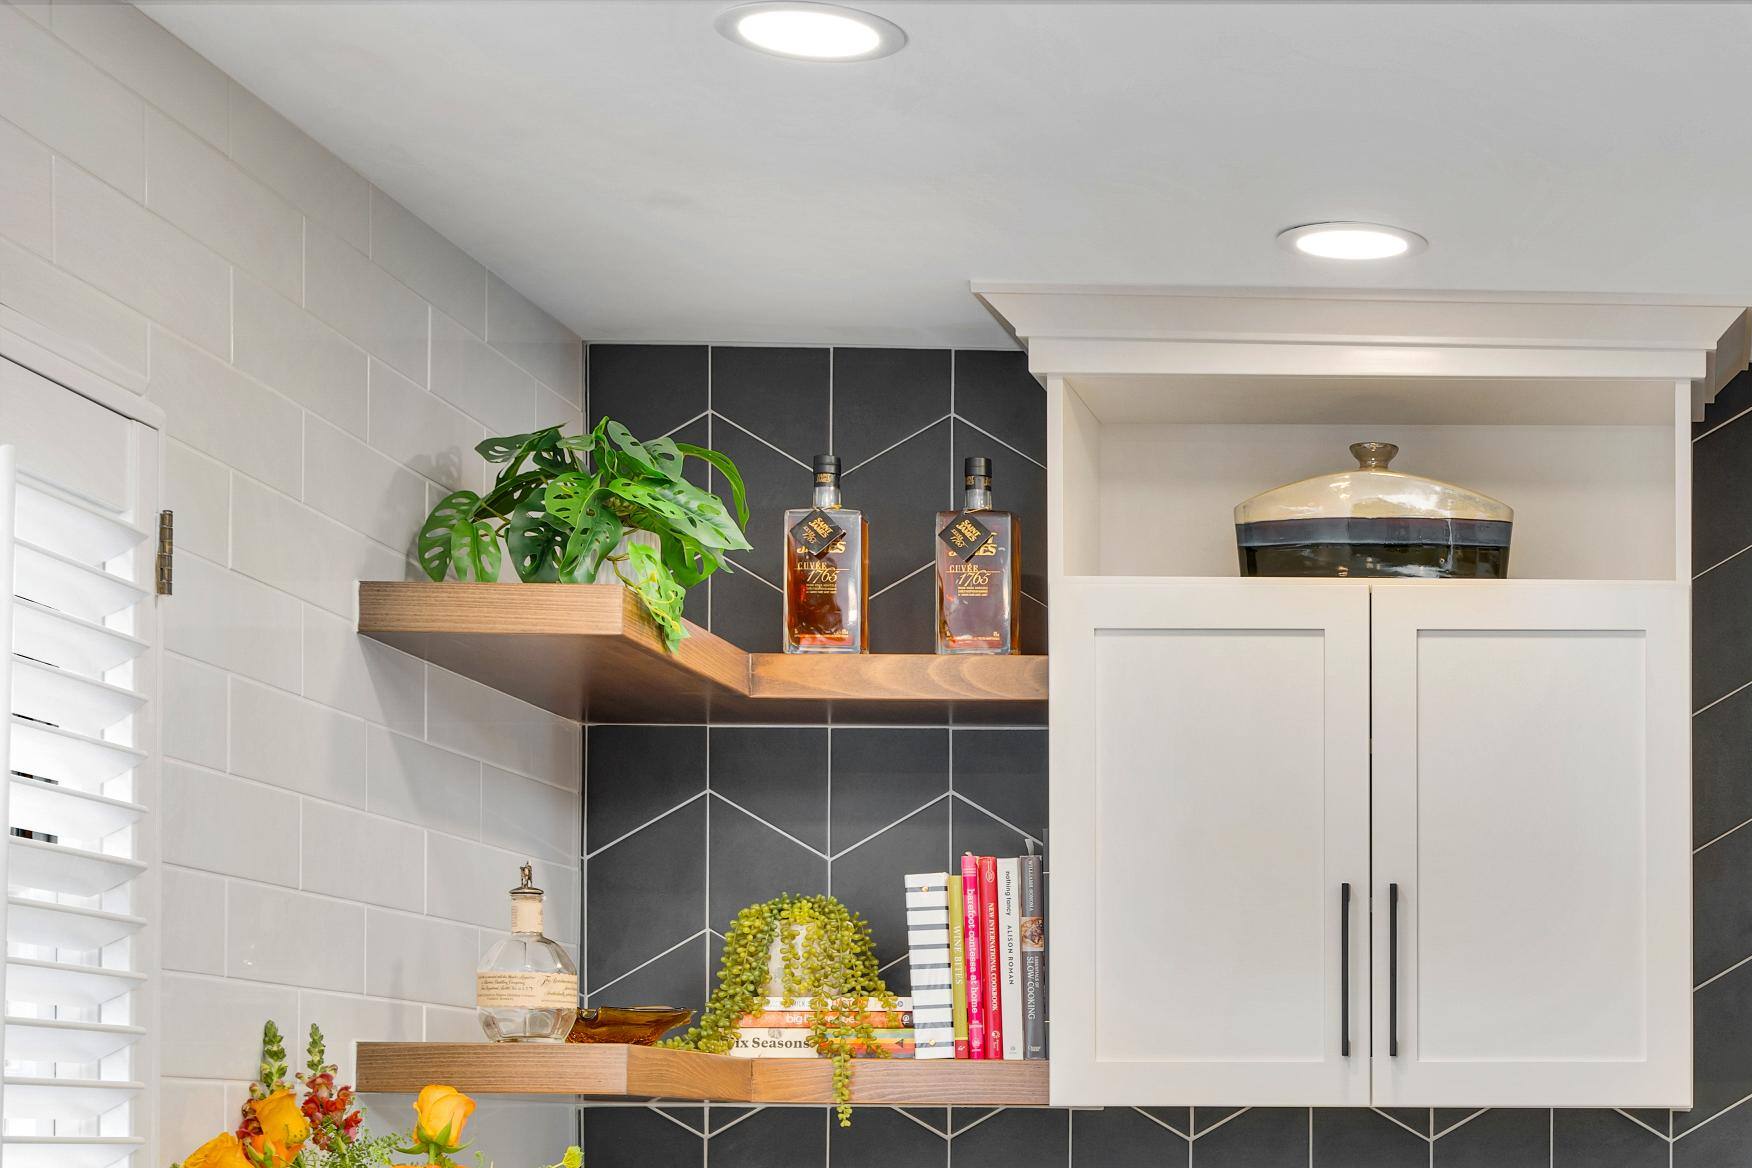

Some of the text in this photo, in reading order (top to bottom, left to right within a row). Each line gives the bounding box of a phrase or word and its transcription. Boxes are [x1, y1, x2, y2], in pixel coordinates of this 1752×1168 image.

[808, 520, 830, 539] JAMES
[817, 517, 834, 534] SAINT
[955, 522, 978, 542] JAMES
[963, 519, 982, 537] SAINT
[797, 560, 828, 570] CUVÉE
[949, 563, 980, 573] CUVÉE
[806, 567, 840, 584] 1765
[958, 569, 992, 587] 1765
[967, 888, 977, 929] barefoot
[953, 925, 963, 985] WINE BITES
[968, 930, 978, 973] contessa
[987, 902, 999, 1012] NEW INTERNATIONAL COOKBOOK
[970, 974, 978, 985] at
[1026, 956, 1036, 1020] SLOW COOKING
[970, 986, 979, 1014] home
[786, 1013, 803, 1024] big
[751, 1037, 810, 1049] Seasons
